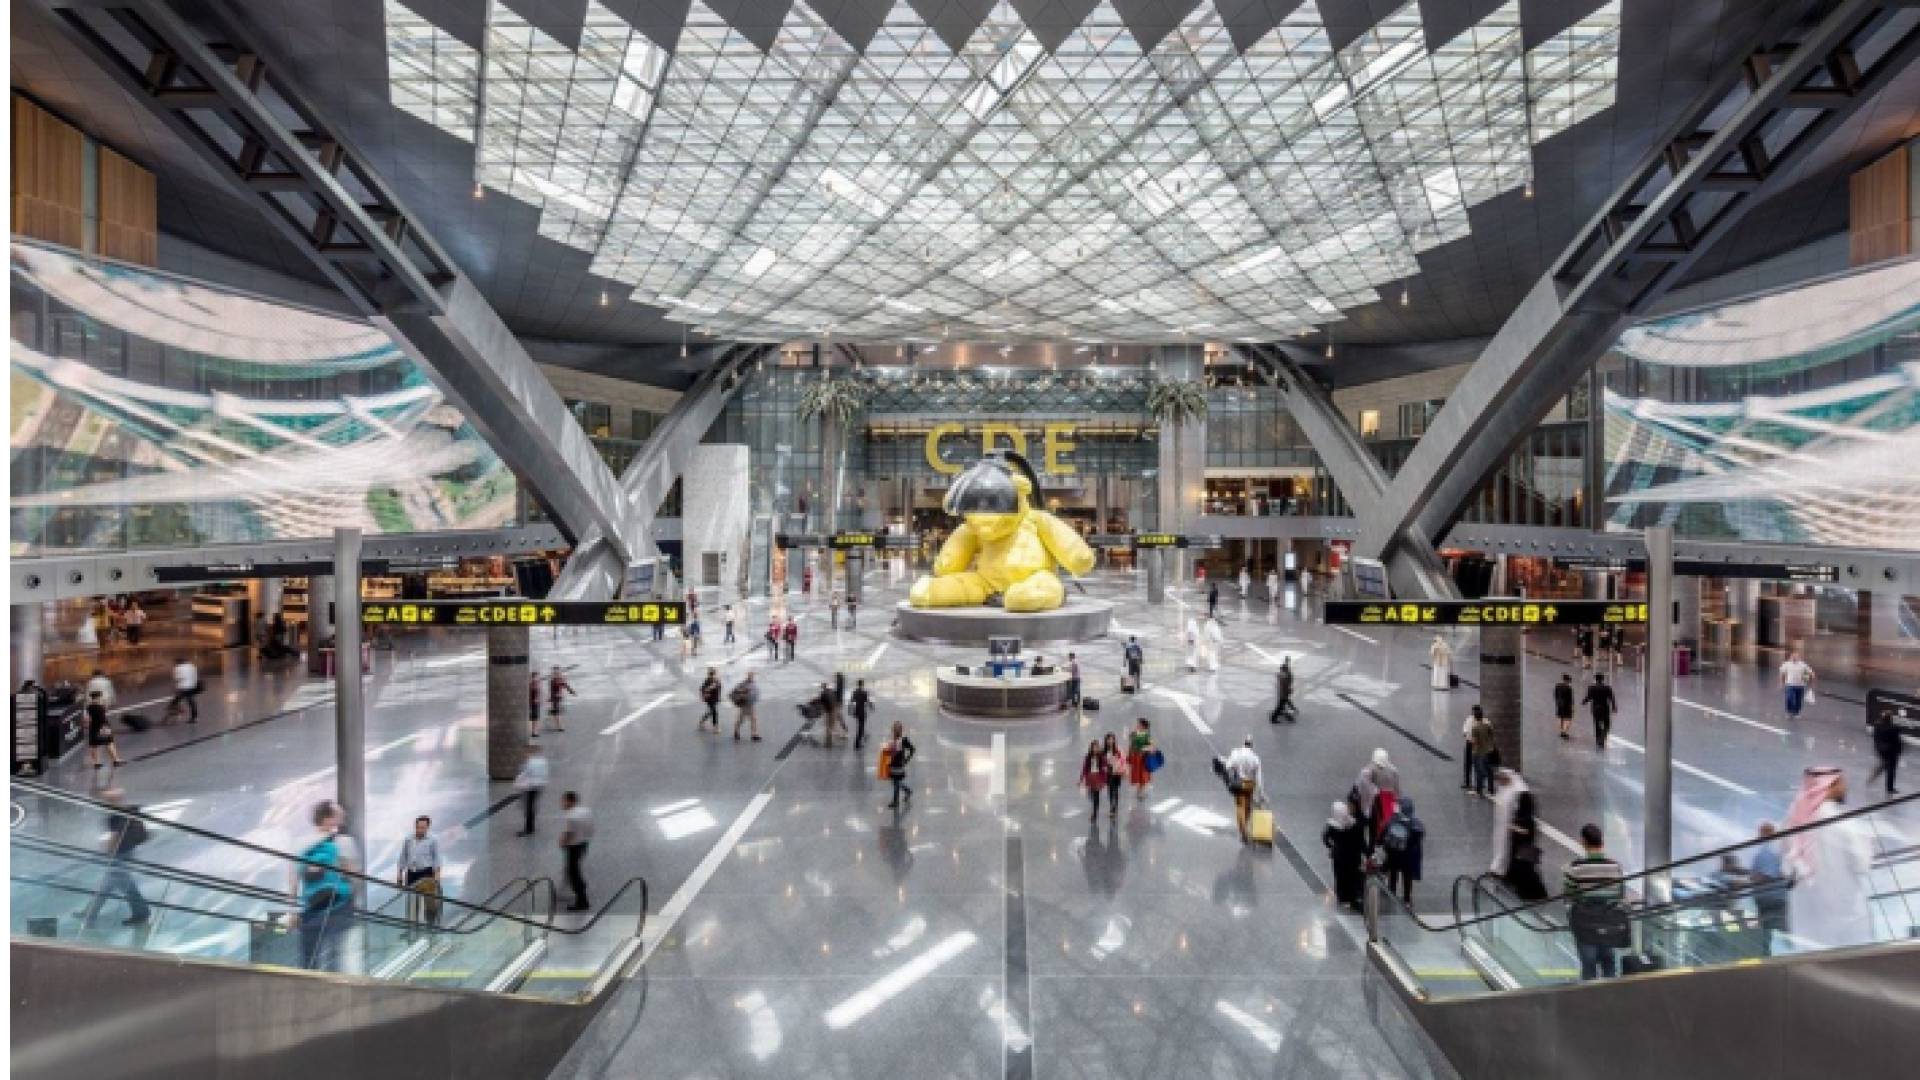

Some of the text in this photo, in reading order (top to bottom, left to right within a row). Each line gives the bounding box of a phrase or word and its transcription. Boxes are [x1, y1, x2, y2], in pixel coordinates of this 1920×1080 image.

[386, 607, 399, 622] A
[480, 607, 517, 622] CDE
[1385, 607, 1399, 622] A
[1482, 607, 1521, 622] CDE
